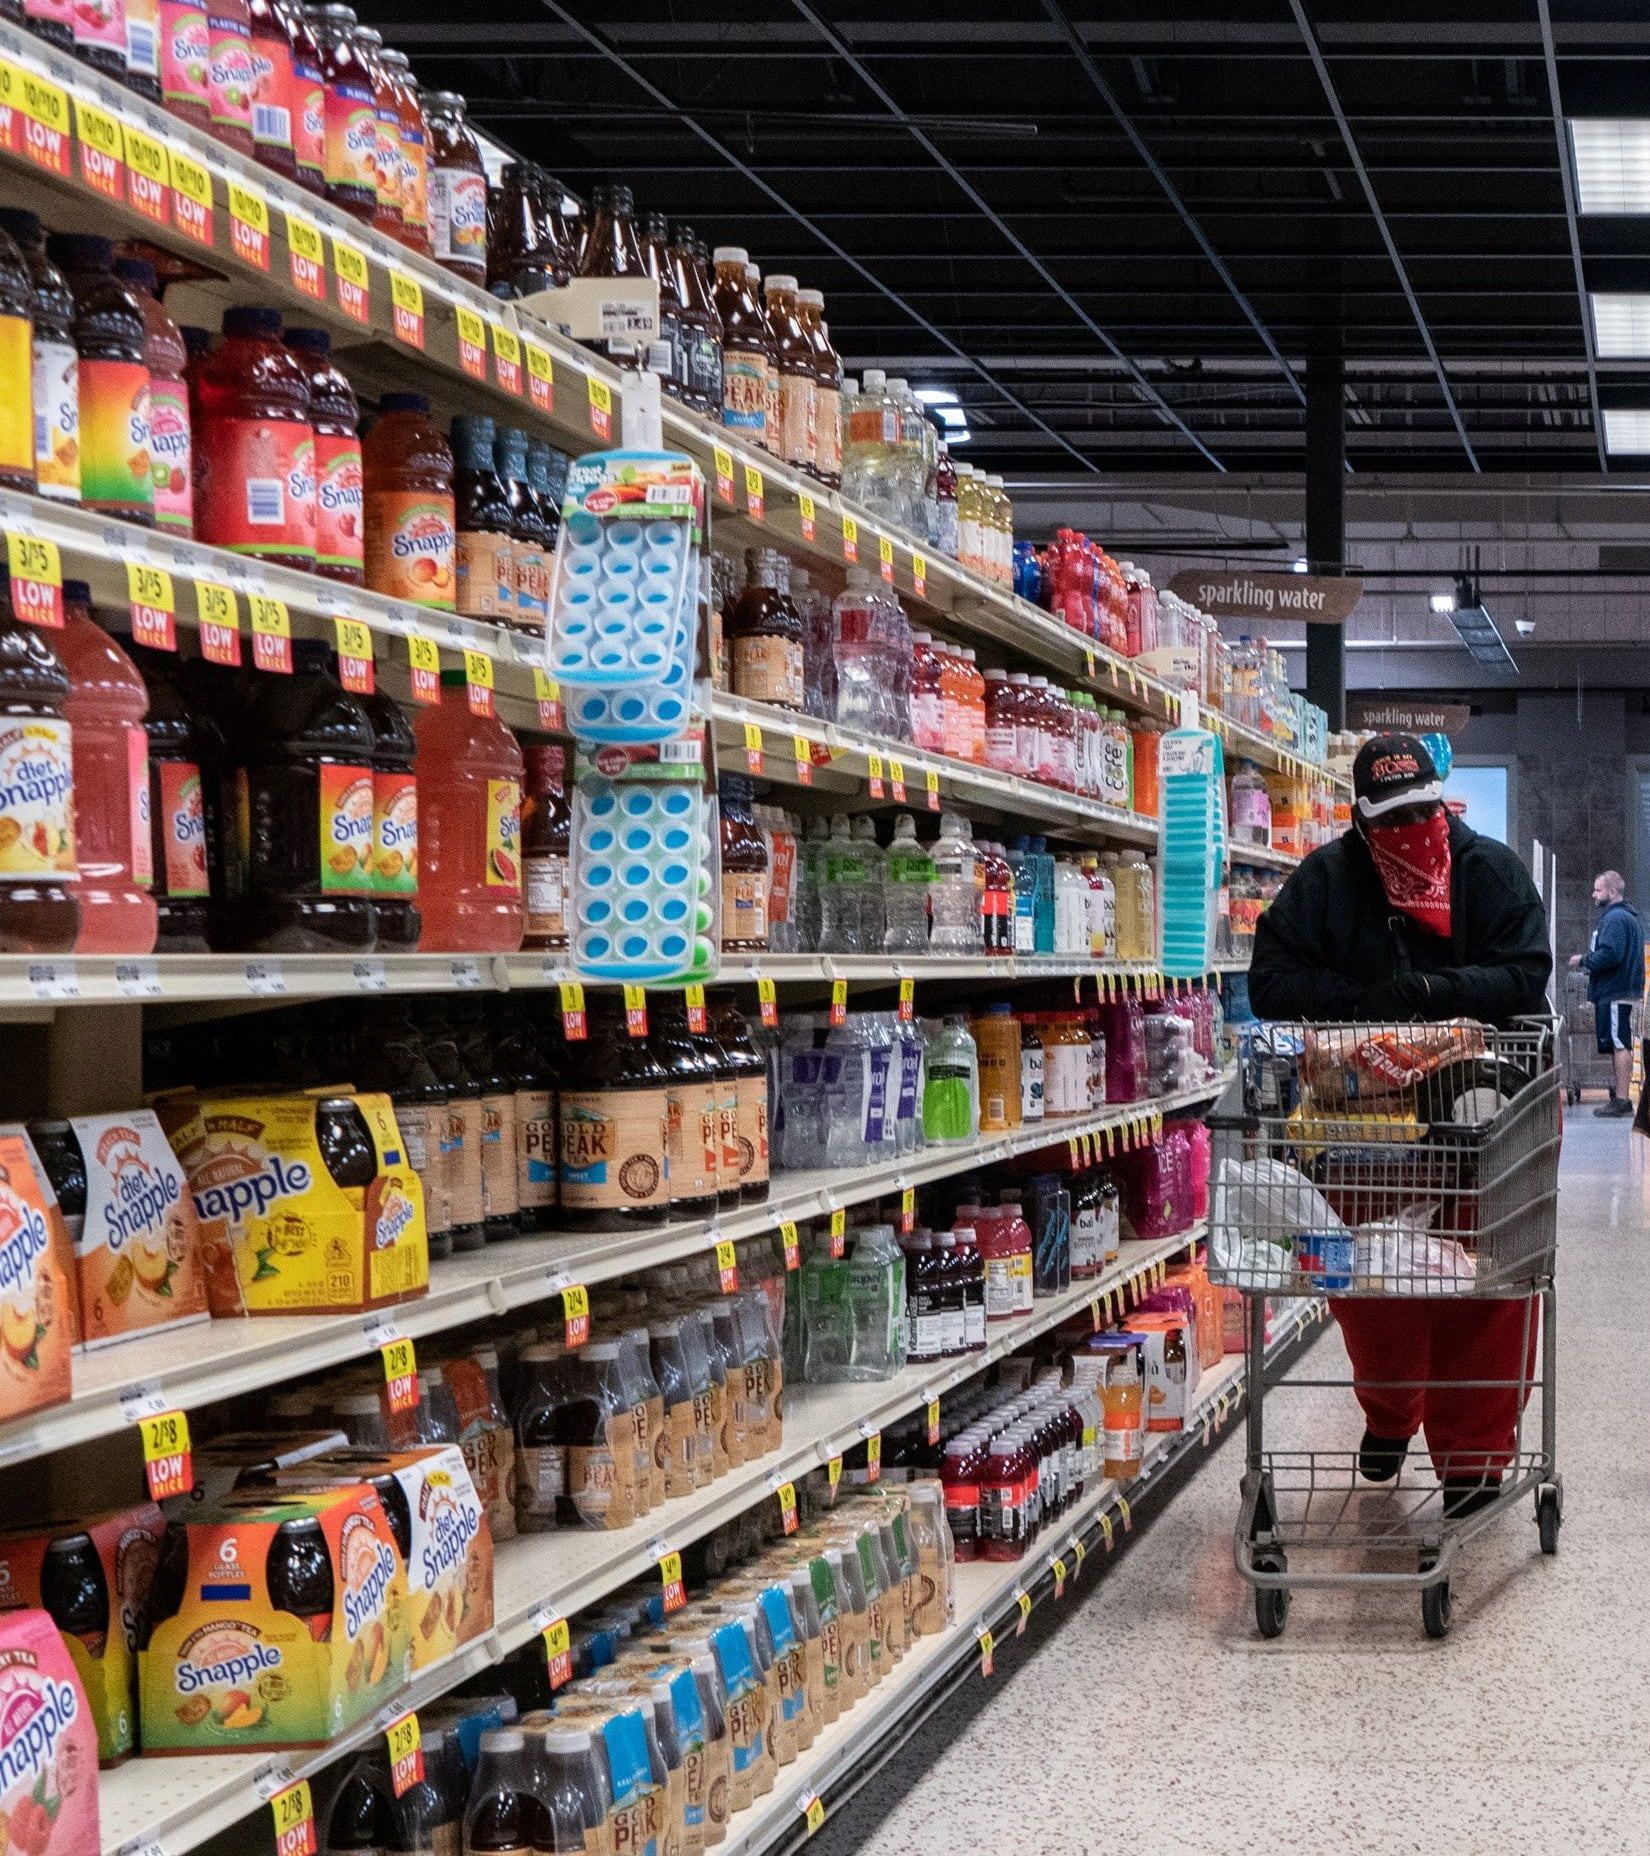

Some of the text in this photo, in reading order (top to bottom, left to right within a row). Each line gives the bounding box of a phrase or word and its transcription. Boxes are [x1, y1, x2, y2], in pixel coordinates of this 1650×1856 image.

[25, 117, 60, 150] LOW
[84, 145, 115, 177] LOW
[131, 173, 161, 203] LOW
[175, 192, 205, 222] LOW
[234, 220, 262, 250] LOW
[292, 255, 318, 281] LOW
[339, 279, 362, 302] LOW
[396, 310, 420, 331] LOW
[462, 343, 481, 362] LOW
[532, 380, 549, 399] LOW
[17, 580, 55, 608] LOW
[1199, 581, 1326, 611] sparkling water
[134, 604, 168, 630] LOW
[202, 623, 234, 646] LOW
[256, 631, 287, 655] LOW
[341, 655, 367, 678] LOW
[412, 670, 437, 690] LOW
[1363, 707, 1445, 728] sparkling water
[17, 761, 53, 782] diet
[1112, 747, 1125, 791] core
[565, 1011, 582, 1027] LOW
[375, 1112, 387, 1132] 6
[120, 1168, 148, 1201] diet
[104, 1166, 179, 1249] Snapple
[376, 1201, 414, 1249] Snapple
[569, 1318, 586, 1336] LOW
[388, 1378, 412, 1399] LOW
[150, 1458, 182, 1484] LOW
[435, 1508, 457, 1544] diet
[219, 1537, 238, 1563] 6
[423, 1503, 478, 1590] Snapple
[345, 1542, 395, 1639] Snapple
[665, 1583, 681, 1602] LOW
[15, 1651, 37, 1666] TEA
[178, 1643, 281, 1692] Snapple
[0, 1683, 74, 1792] napple
[394, 1756, 418, 1784] LOW
[278, 1822, 309, 1850] LOW
